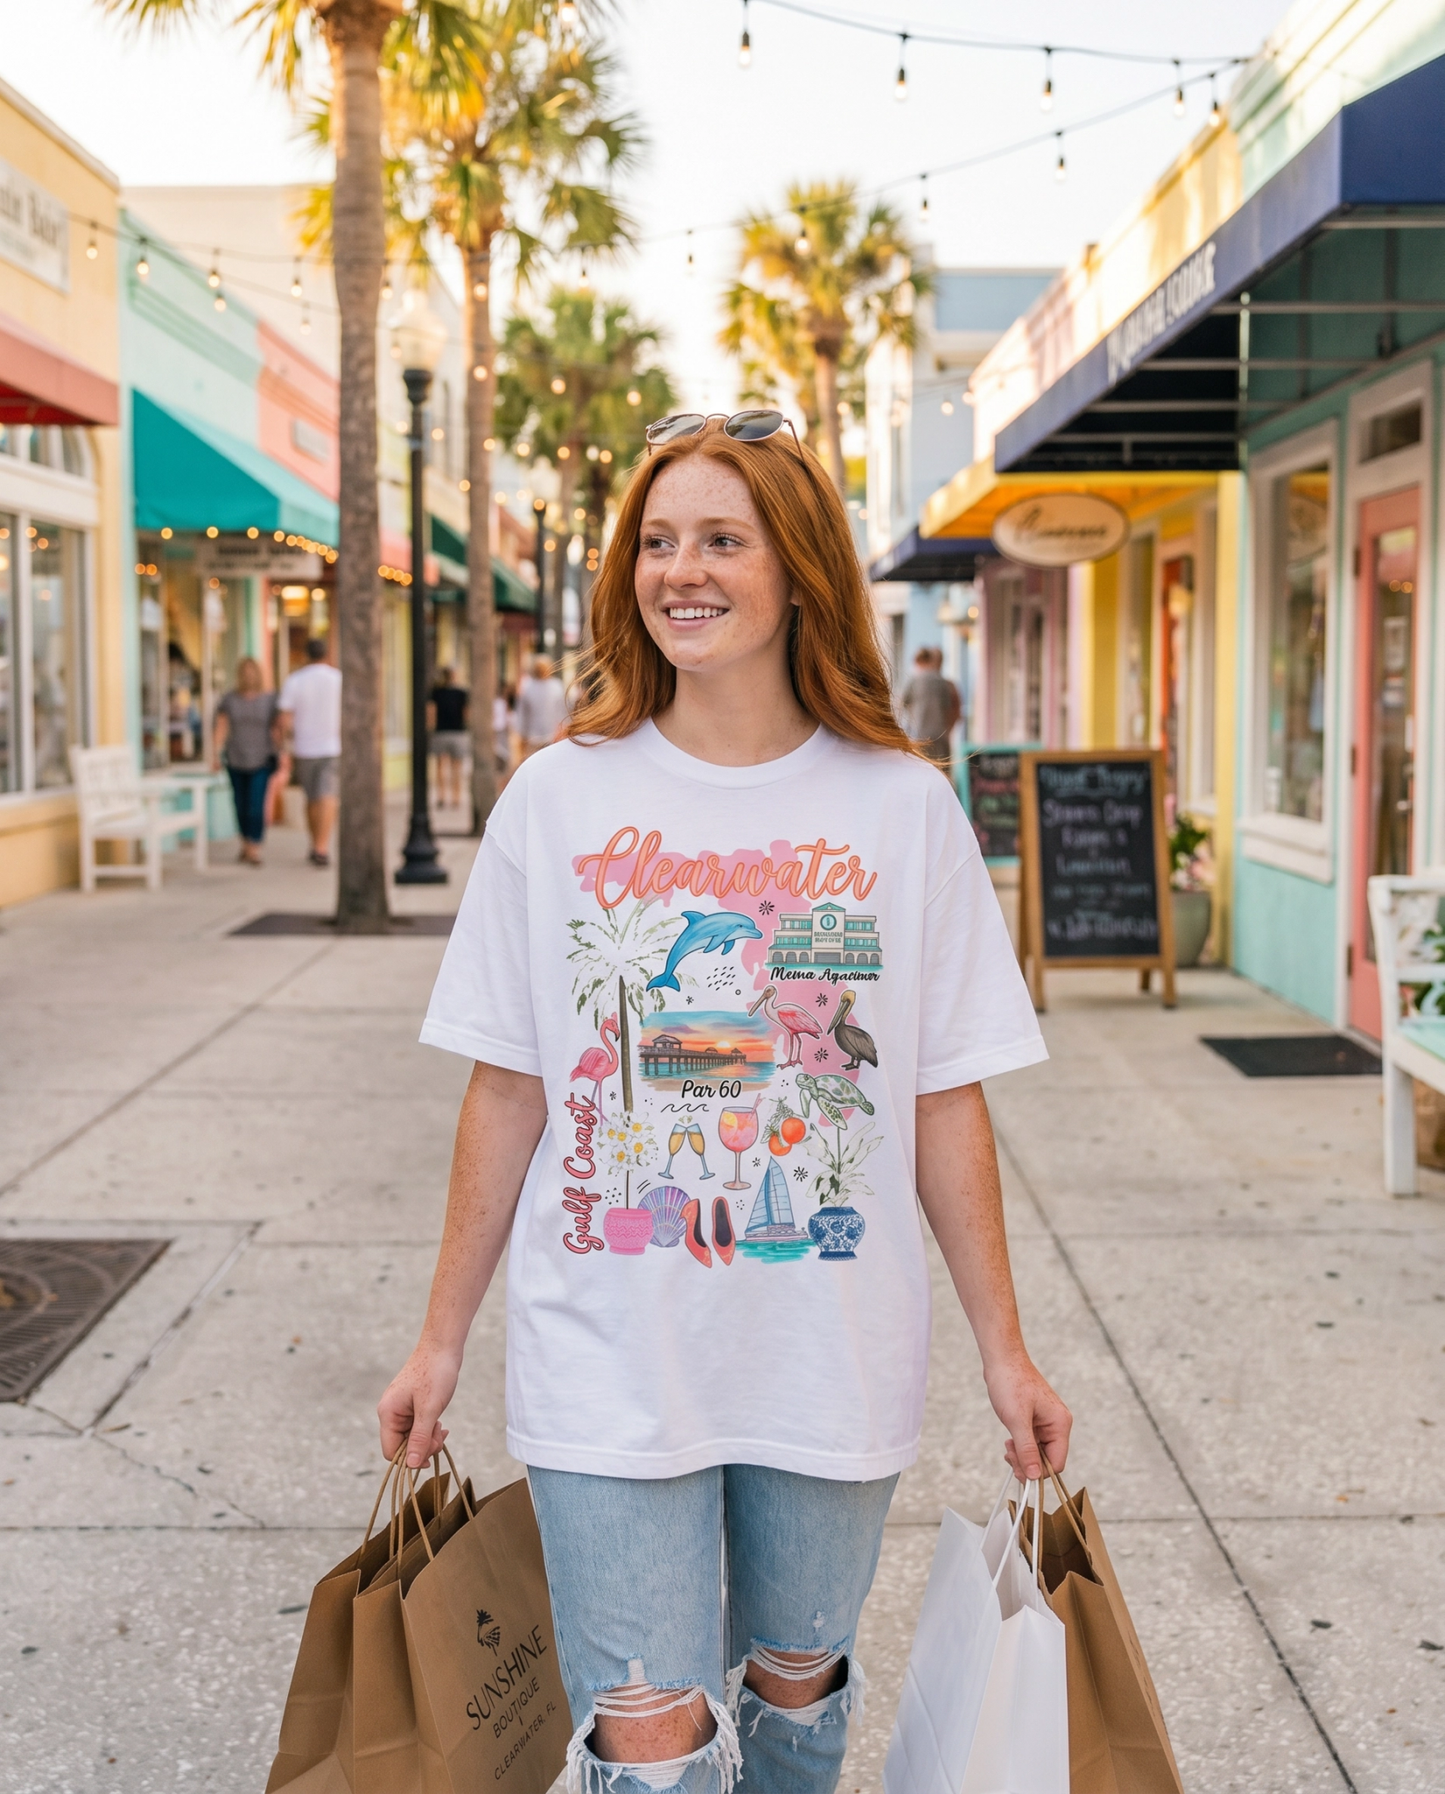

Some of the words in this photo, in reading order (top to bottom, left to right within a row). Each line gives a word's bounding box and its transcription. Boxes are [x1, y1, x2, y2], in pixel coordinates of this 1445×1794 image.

[577, 826, 878, 909] Clearwater
[681, 1079, 716, 1099] Par
[719, 1080, 742, 1098] 60
[563, 1092, 598, 1180] Coast
[562, 1186, 605, 1254] Gulf
[466, 1624, 548, 1731] SUNSHINE
[493, 1676, 540, 1739] BOUTIQUE
[546, 1701, 557, 1716] FL
